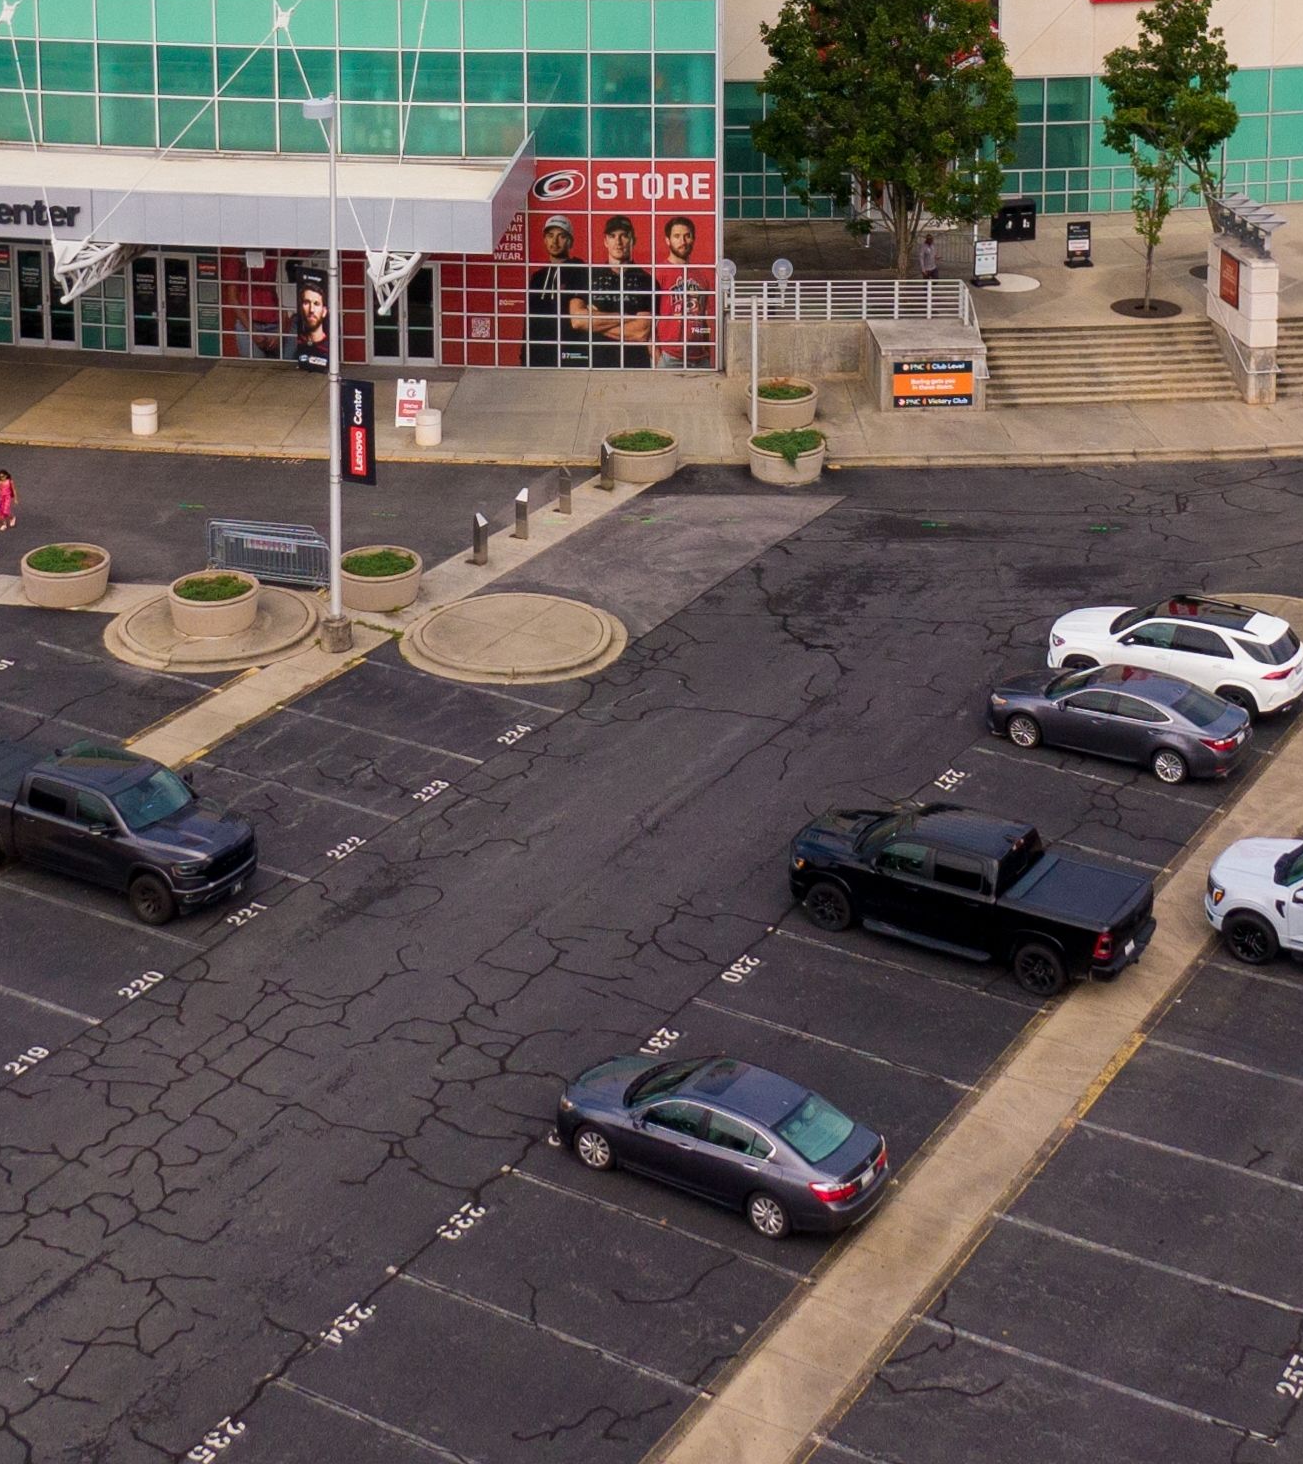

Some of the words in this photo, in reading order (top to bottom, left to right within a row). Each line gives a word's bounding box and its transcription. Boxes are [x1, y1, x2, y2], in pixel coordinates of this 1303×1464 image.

[596, 172, 711, 200] STORE
[505, 233, 523, 242] THE
[494, 252, 524, 260] WEAR.
[353, 388, 363, 425] Center
[928, 398, 951, 406] Victory
[354, 430, 363, 472] Lenovo
[496, 724, 532, 745] 224
[412, 780, 450, 802] 223
[933, 768, 966, 791] 227
[326, 836, 367, 860] 222
[226, 902, 268, 927] 221
[721, 954, 761, 983] 230
[117, 970, 164, 1000] 220
[639, 1027, 680, 1054] 231
[4, 1046, 50, 1075] 219
[187, 1416, 246, 1464] 235
